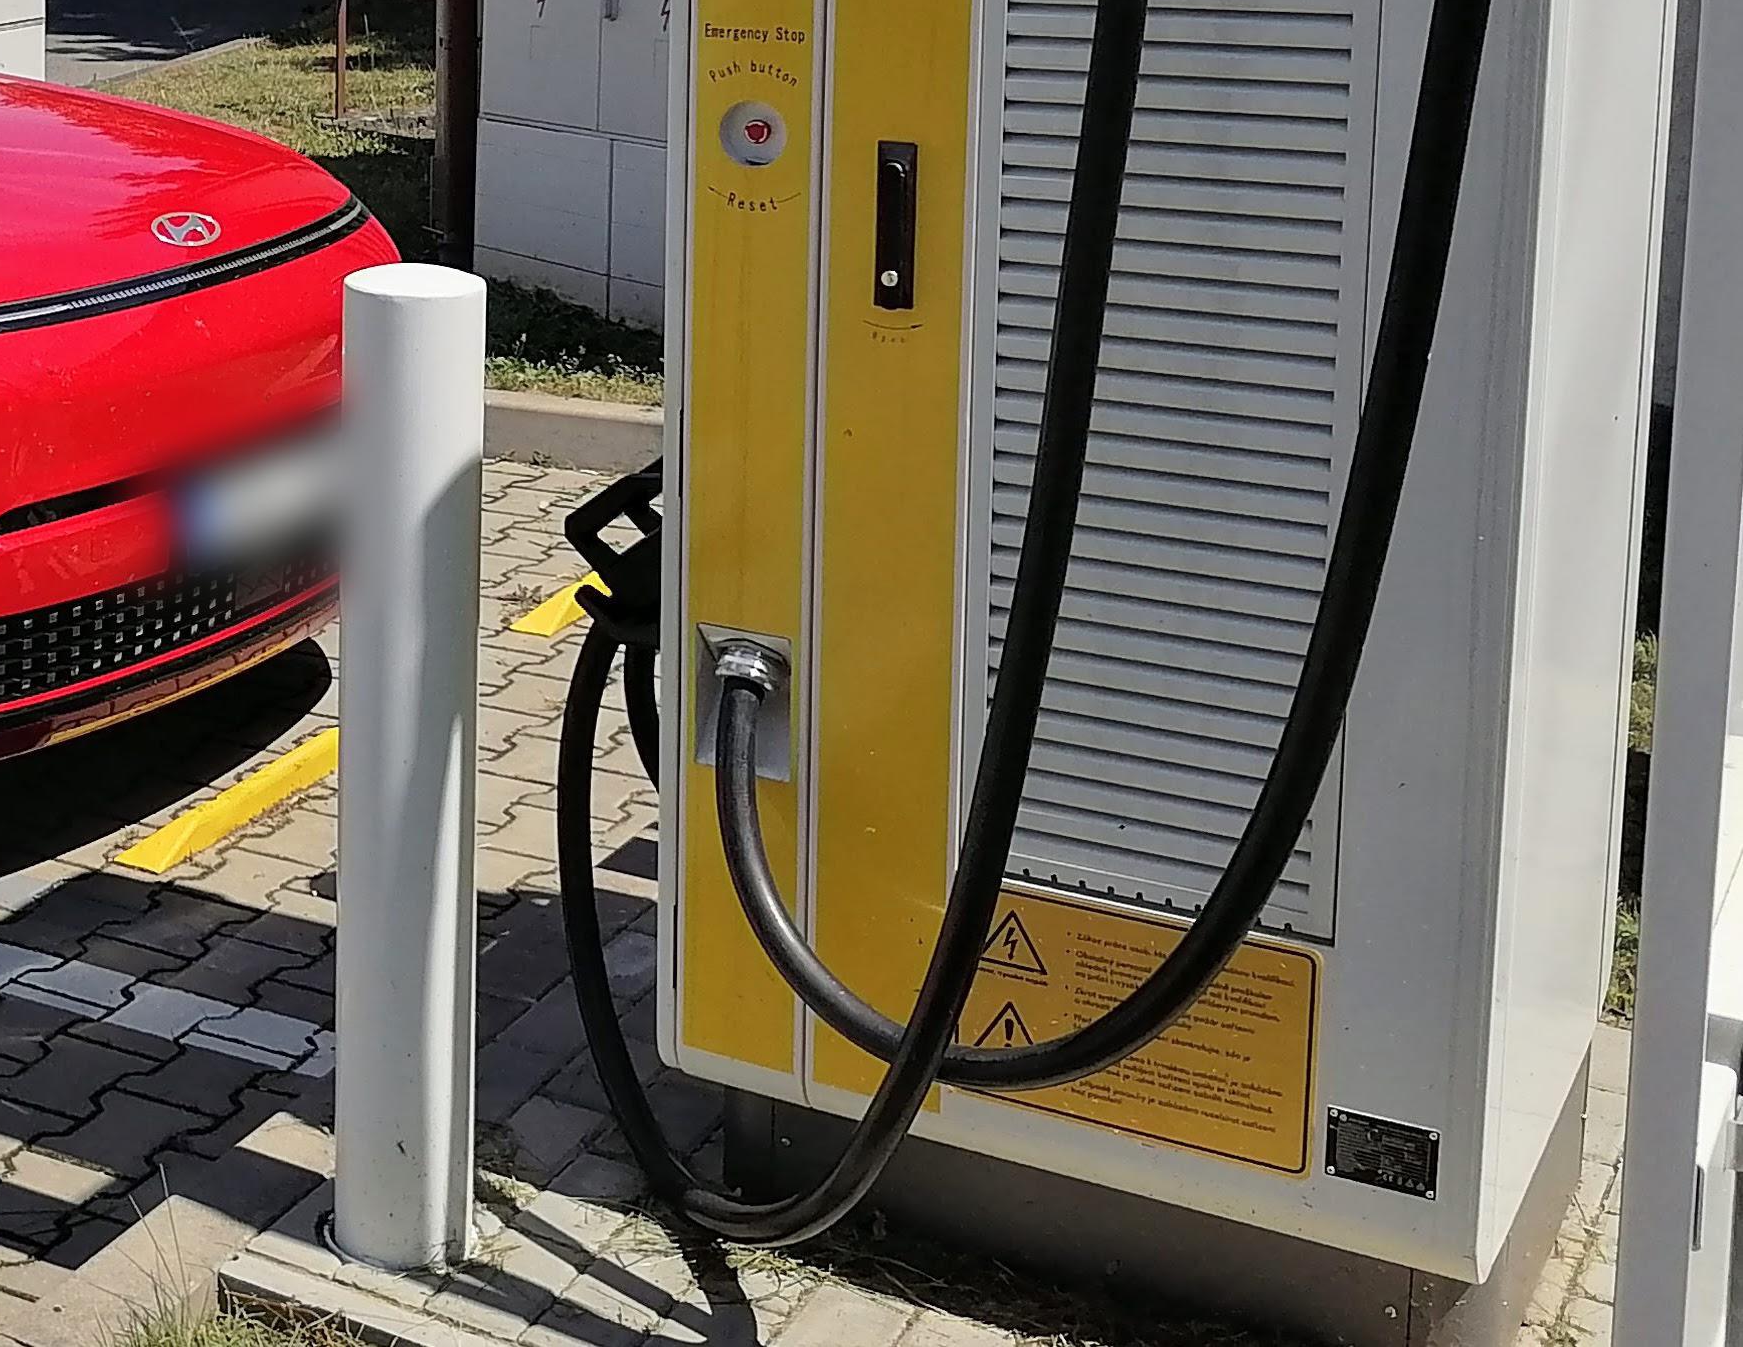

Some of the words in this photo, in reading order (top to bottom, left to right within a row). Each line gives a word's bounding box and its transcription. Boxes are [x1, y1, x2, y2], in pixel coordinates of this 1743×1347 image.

[704, 23, 769, 42] Emergency
[775, 26, 806, 44] Stop
[708, 60, 741, 82] Push
[750, 59, 798, 87] button
[726, 191, 778, 212] Reset
